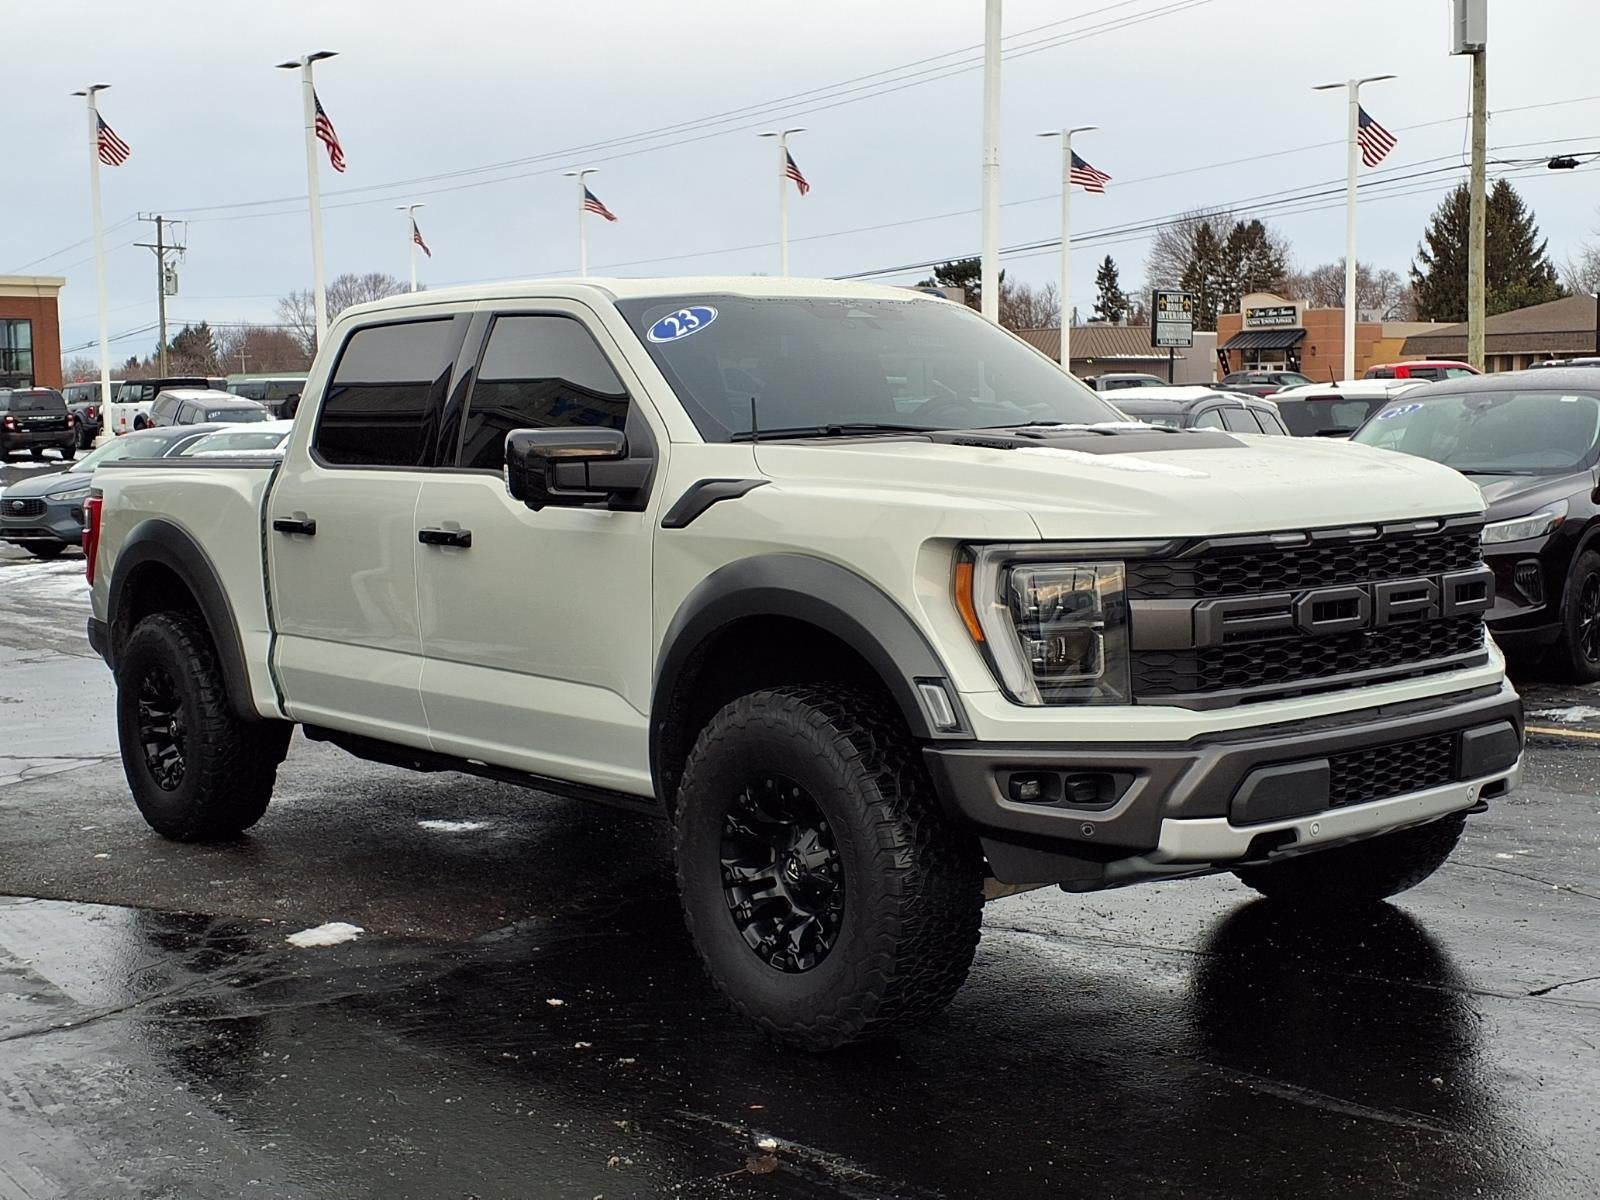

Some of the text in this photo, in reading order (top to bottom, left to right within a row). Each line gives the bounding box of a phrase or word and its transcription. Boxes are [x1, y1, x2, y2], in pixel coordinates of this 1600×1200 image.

[1166, 294, 1184, 302] DOWN
[1166, 303, 1184, 311] HOME
[1158, 311, 1192, 320] INTERIORS
[664, 309, 700, 336] 23
[1195, 564, 1496, 647] FORD
